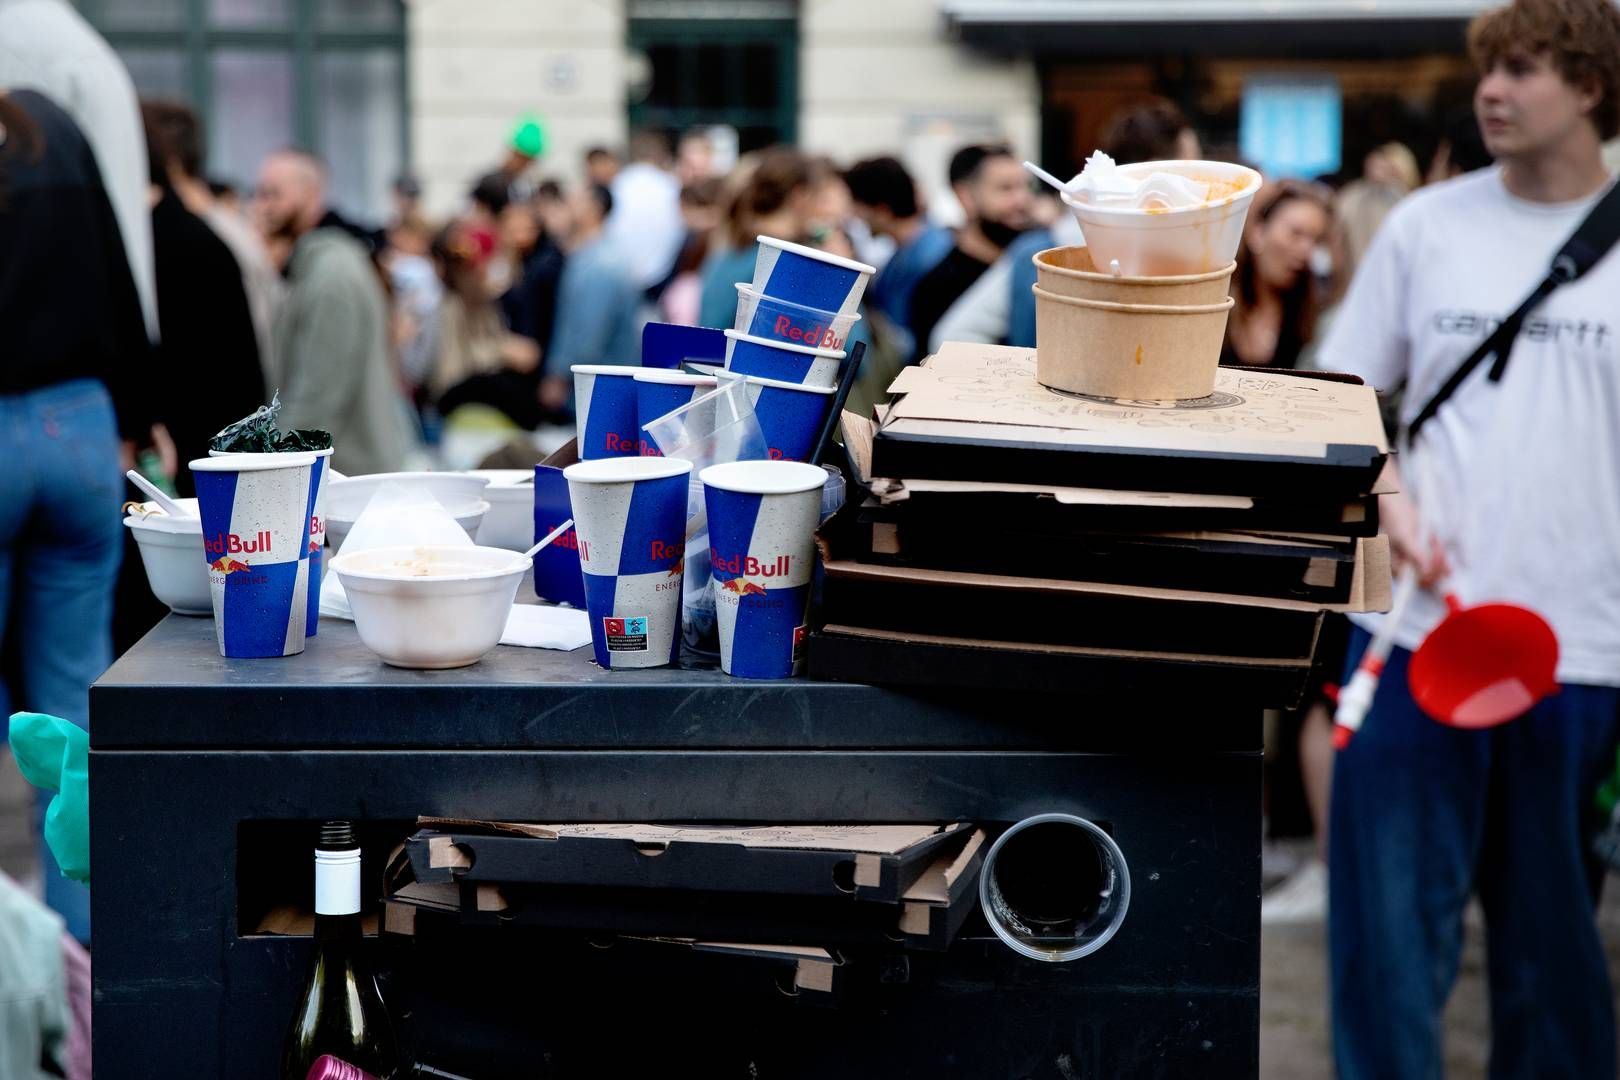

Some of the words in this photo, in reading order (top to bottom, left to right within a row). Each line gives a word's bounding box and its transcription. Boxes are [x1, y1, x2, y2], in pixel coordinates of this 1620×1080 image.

[774, 314, 822, 346] Red
[820, 328, 844, 350] Bu
[1433, 308, 1612, 347] carartt
[606, 431, 640, 452] Re
[640, 439, 664, 457] Re
[310, 516, 325, 535] Bu
[204, 533, 224, 553] ed
[227, 531, 271, 553] Bull
[743, 555, 790, 577] Bull
